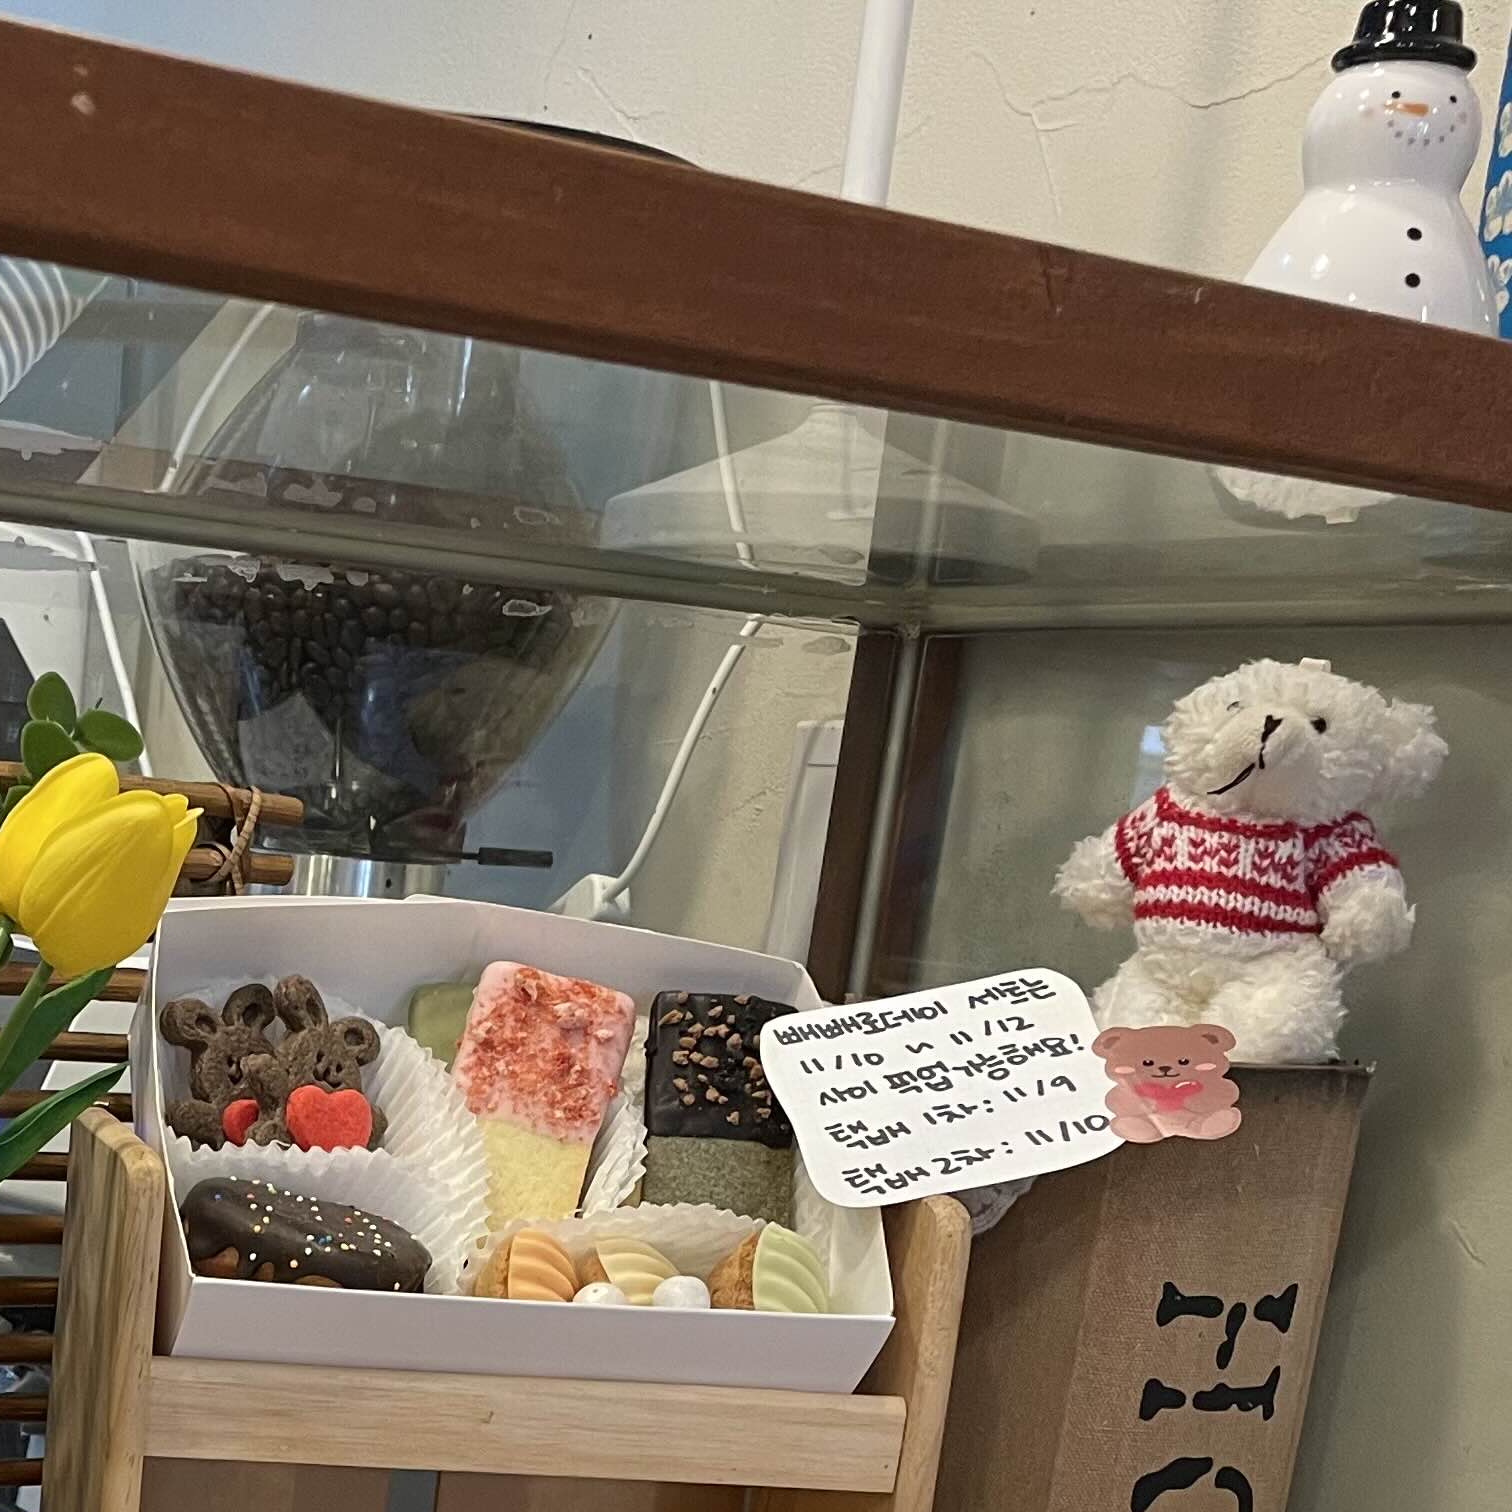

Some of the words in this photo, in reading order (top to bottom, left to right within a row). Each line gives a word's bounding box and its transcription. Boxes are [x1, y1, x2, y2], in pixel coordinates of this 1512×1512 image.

[773, 1000, 949, 1046] 빼빼로데이
[967, 976, 1057, 1010] 세트는
[818, 1079, 879, 1107] 사이
[824, 1119, 912, 1150] 택배
[842, 1161, 931, 1195] 택배
[1024, 1114, 1110, 1148] 11/10
